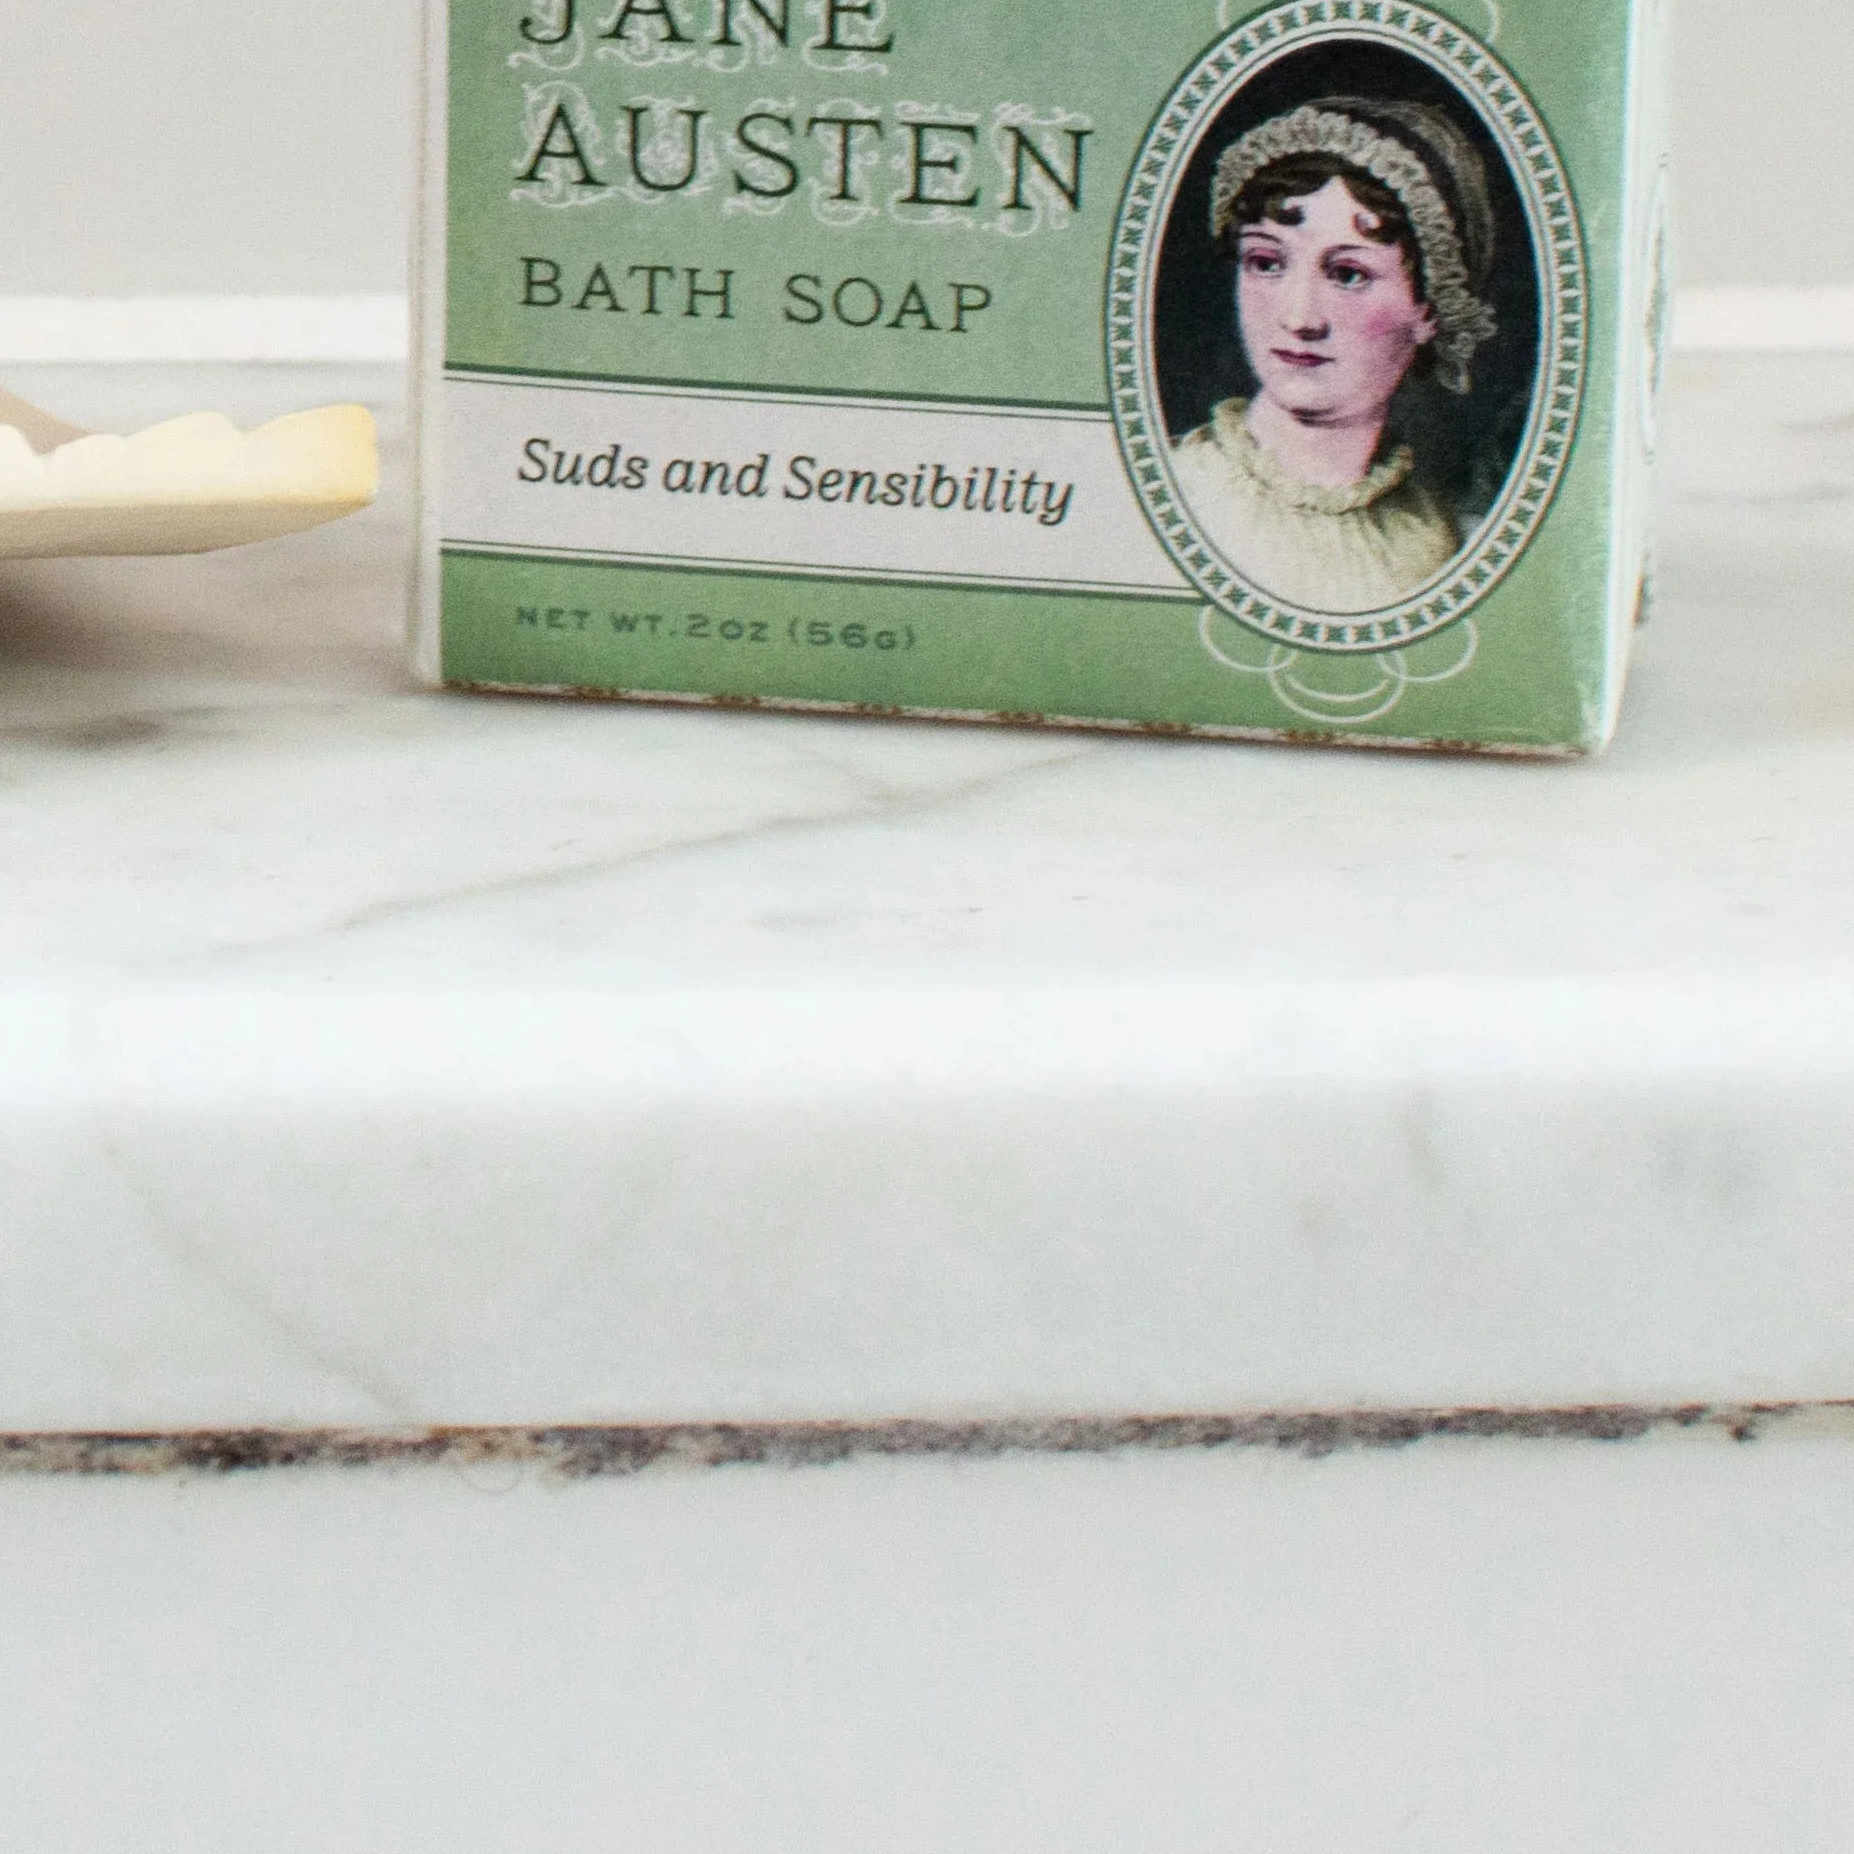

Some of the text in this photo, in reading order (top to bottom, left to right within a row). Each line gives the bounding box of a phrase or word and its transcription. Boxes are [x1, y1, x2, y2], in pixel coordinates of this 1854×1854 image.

[516, 103, 1095, 213] AUSTEN
[518, 257, 992, 333] BATH SOAP
[518, 437, 1075, 526] Suds and Sensibility
[516, 605, 591, 630] NET
